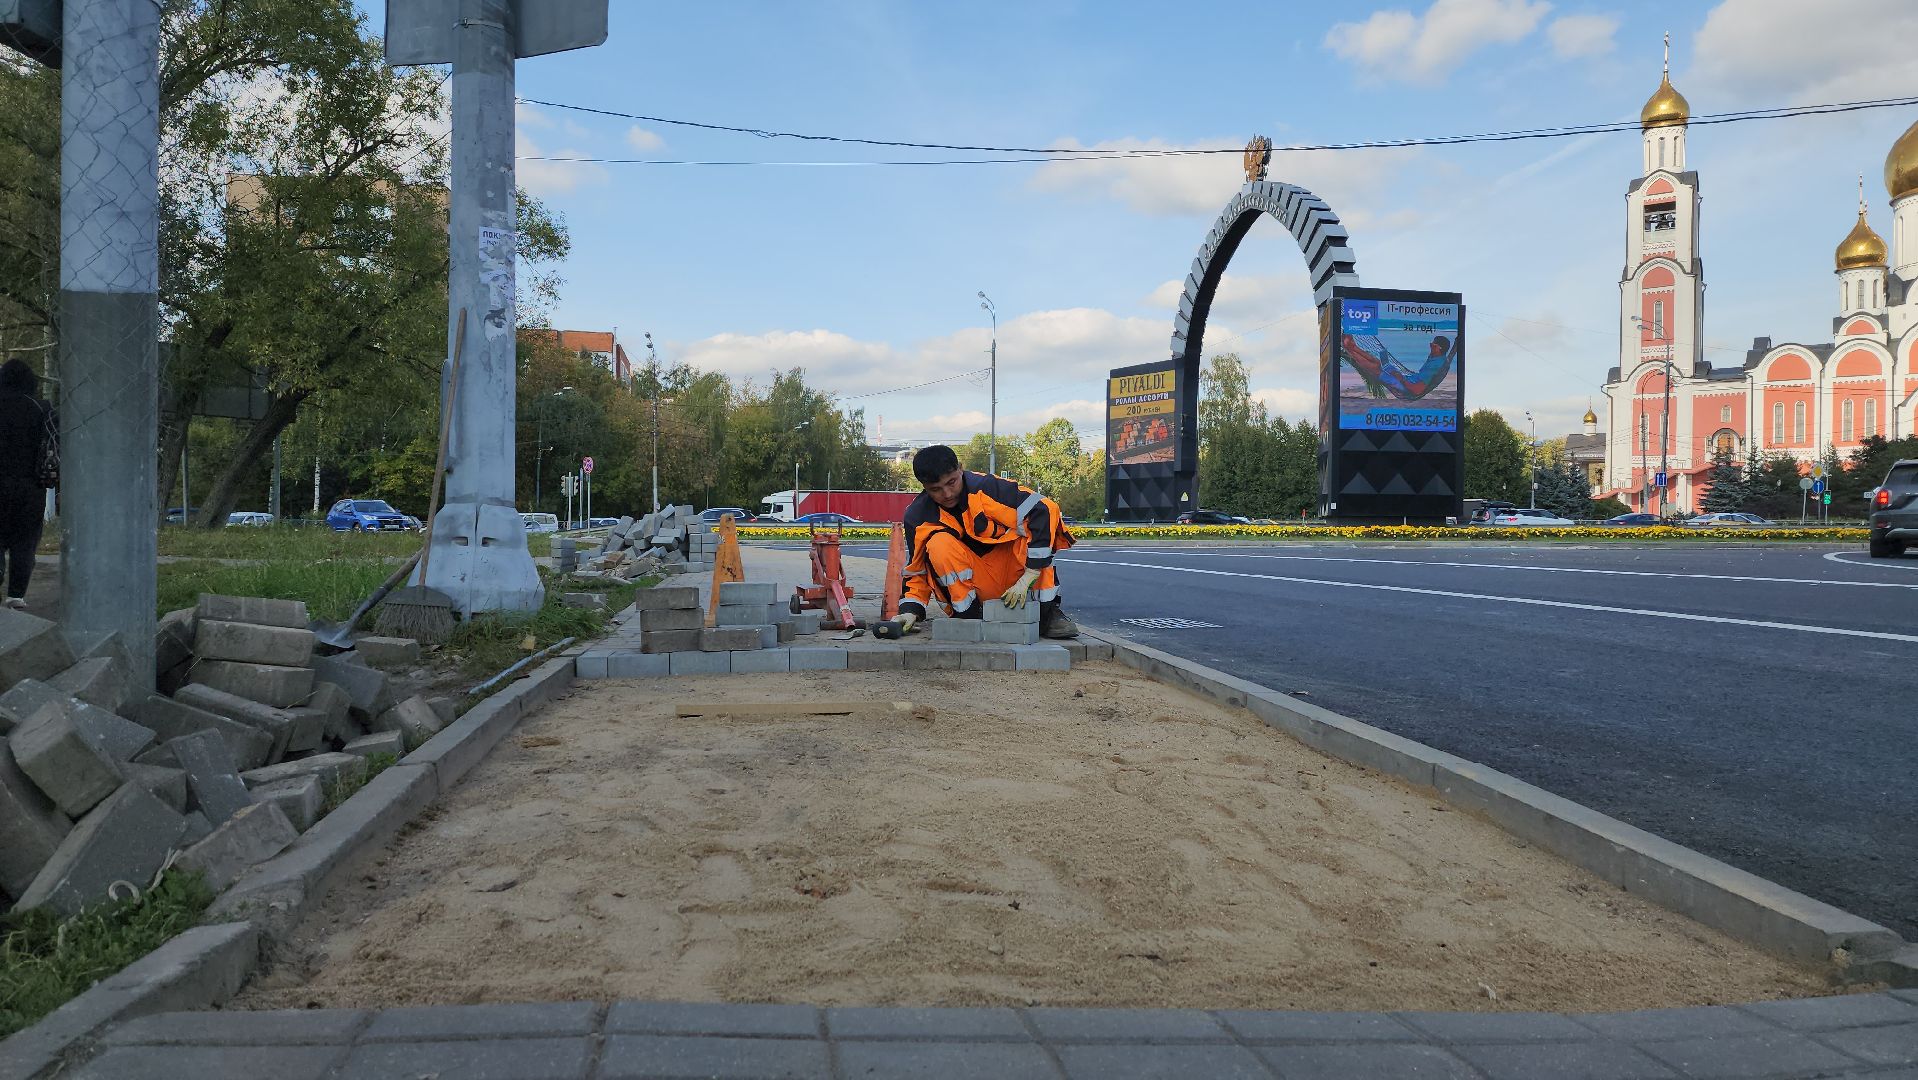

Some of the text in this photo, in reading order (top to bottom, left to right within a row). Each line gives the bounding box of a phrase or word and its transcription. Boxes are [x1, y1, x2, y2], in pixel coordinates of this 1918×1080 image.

[1348, 308, 1372, 323] top
[1403, 322, 1436, 333] за год!
[1119, 373, 1165, 394] PIVALDI
[1115, 392, 1169, 405] РОЛЛЫ АССОРТИ
[1126, 405, 1141, 415] 200
[1365, 413, 1455, 428] 8 (495) 032-54-54
